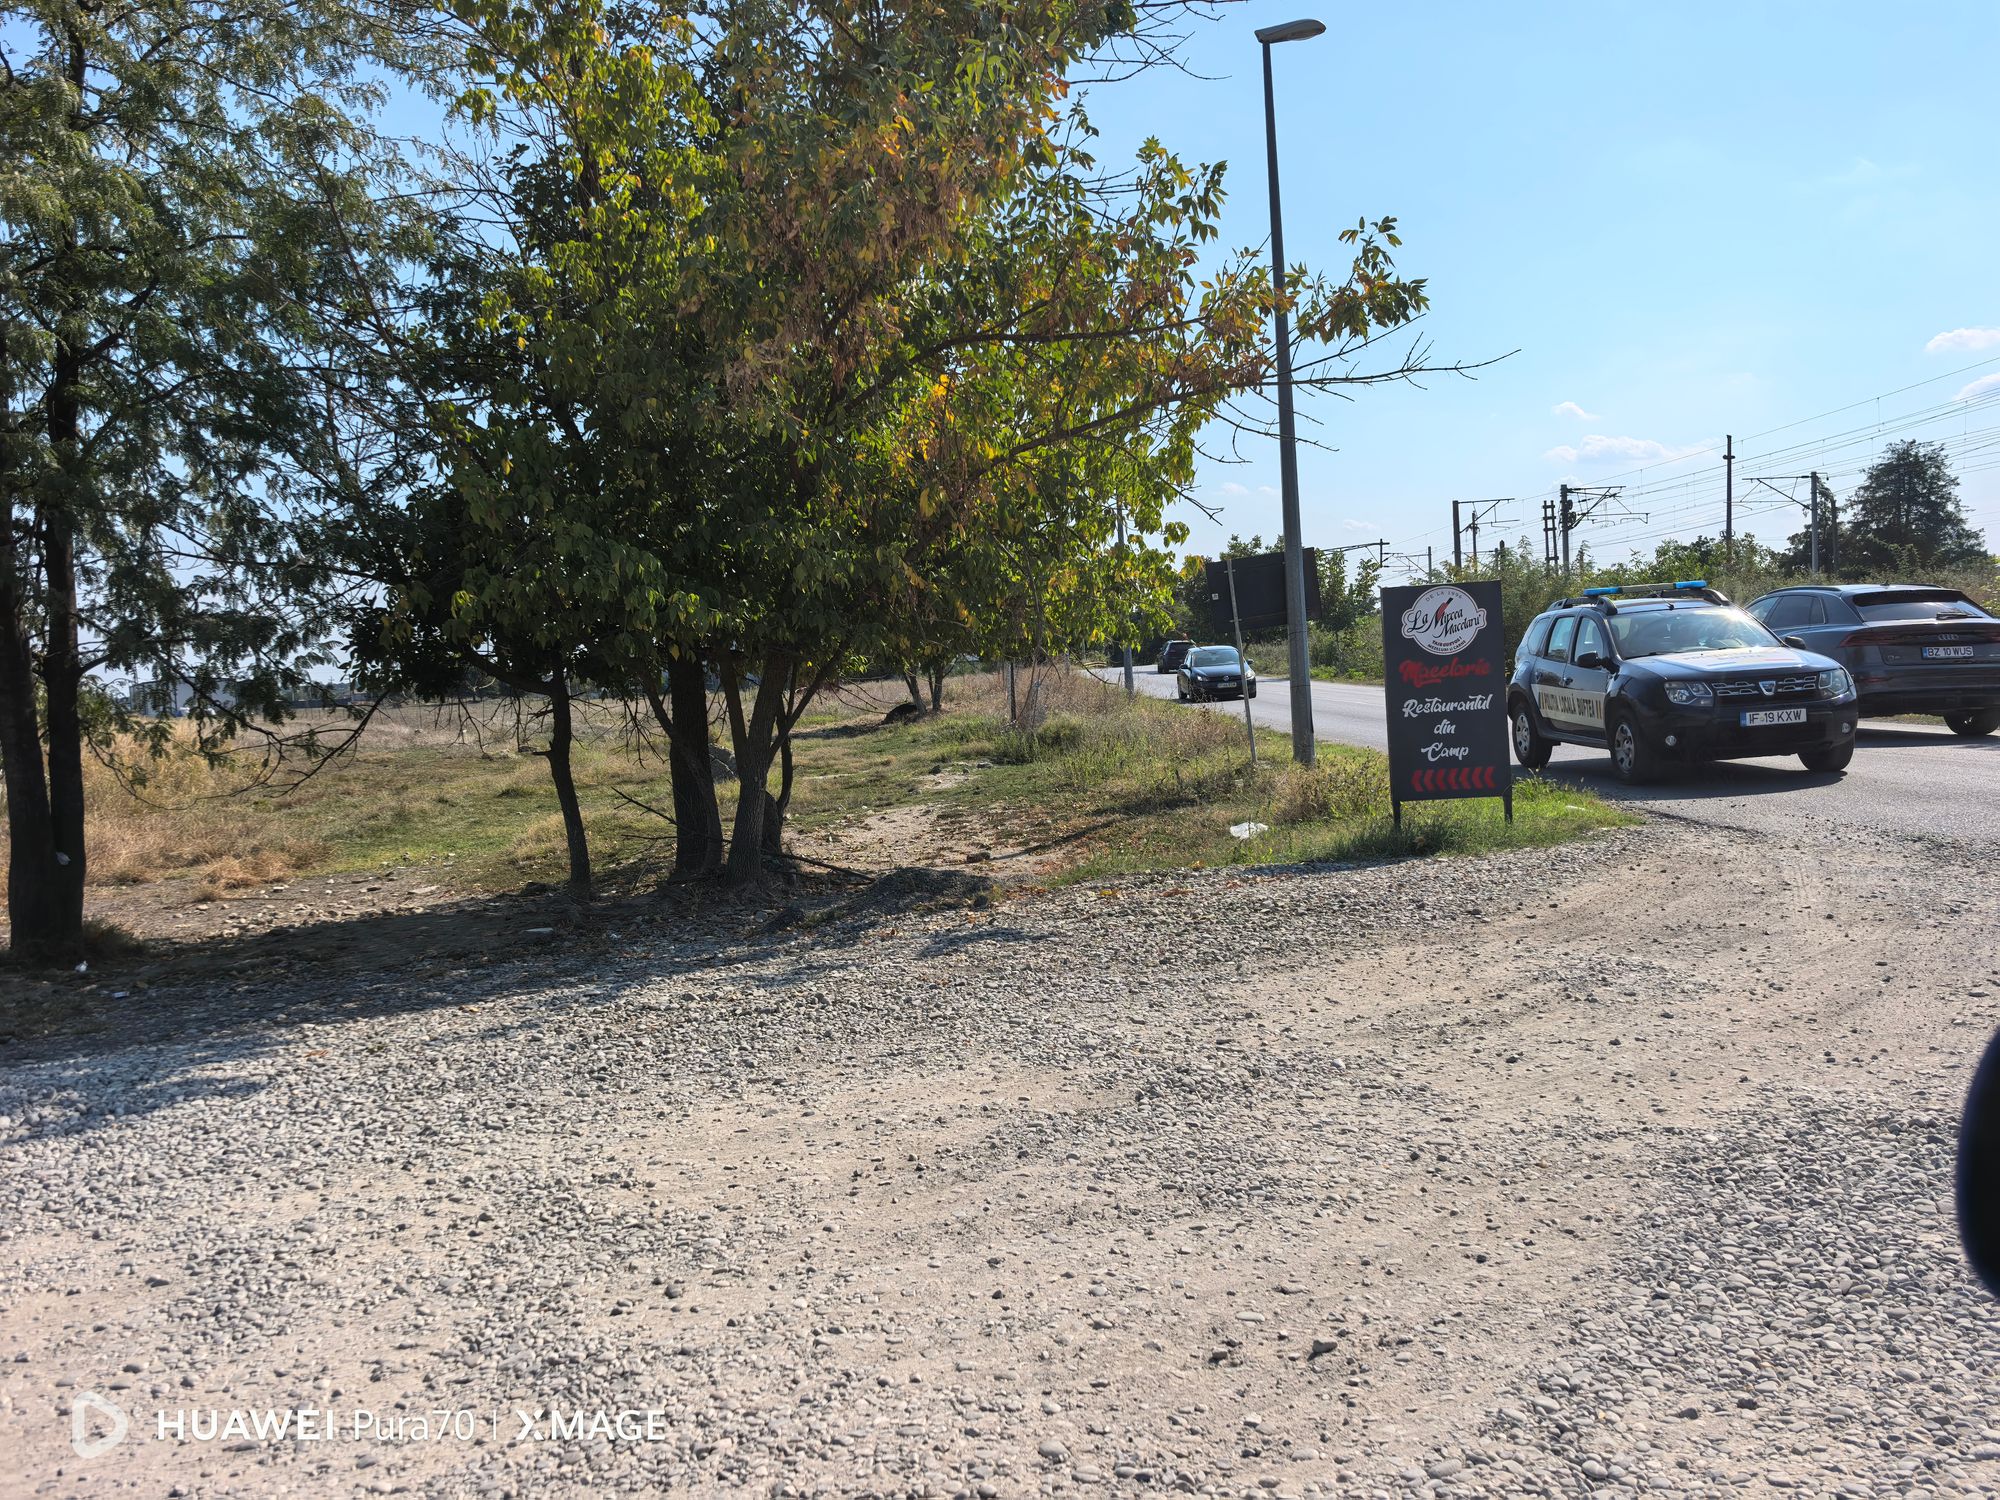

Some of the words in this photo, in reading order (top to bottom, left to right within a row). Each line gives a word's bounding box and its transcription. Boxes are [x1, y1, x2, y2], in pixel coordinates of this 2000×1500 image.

[1407, 610, 1429, 633] La
[1928, 647, 1940, 657] BZ
[1944, 647, 1952, 656] 10
[1952, 646, 1973, 656] WUS
[1402, 694, 1494, 718] Restaurantul
[1764, 712, 1775, 723] 19
[1777, 709, 1802, 722] KXW
[1434, 719, 1456, 735] din
[1421, 742, 1469, 762] Camp
